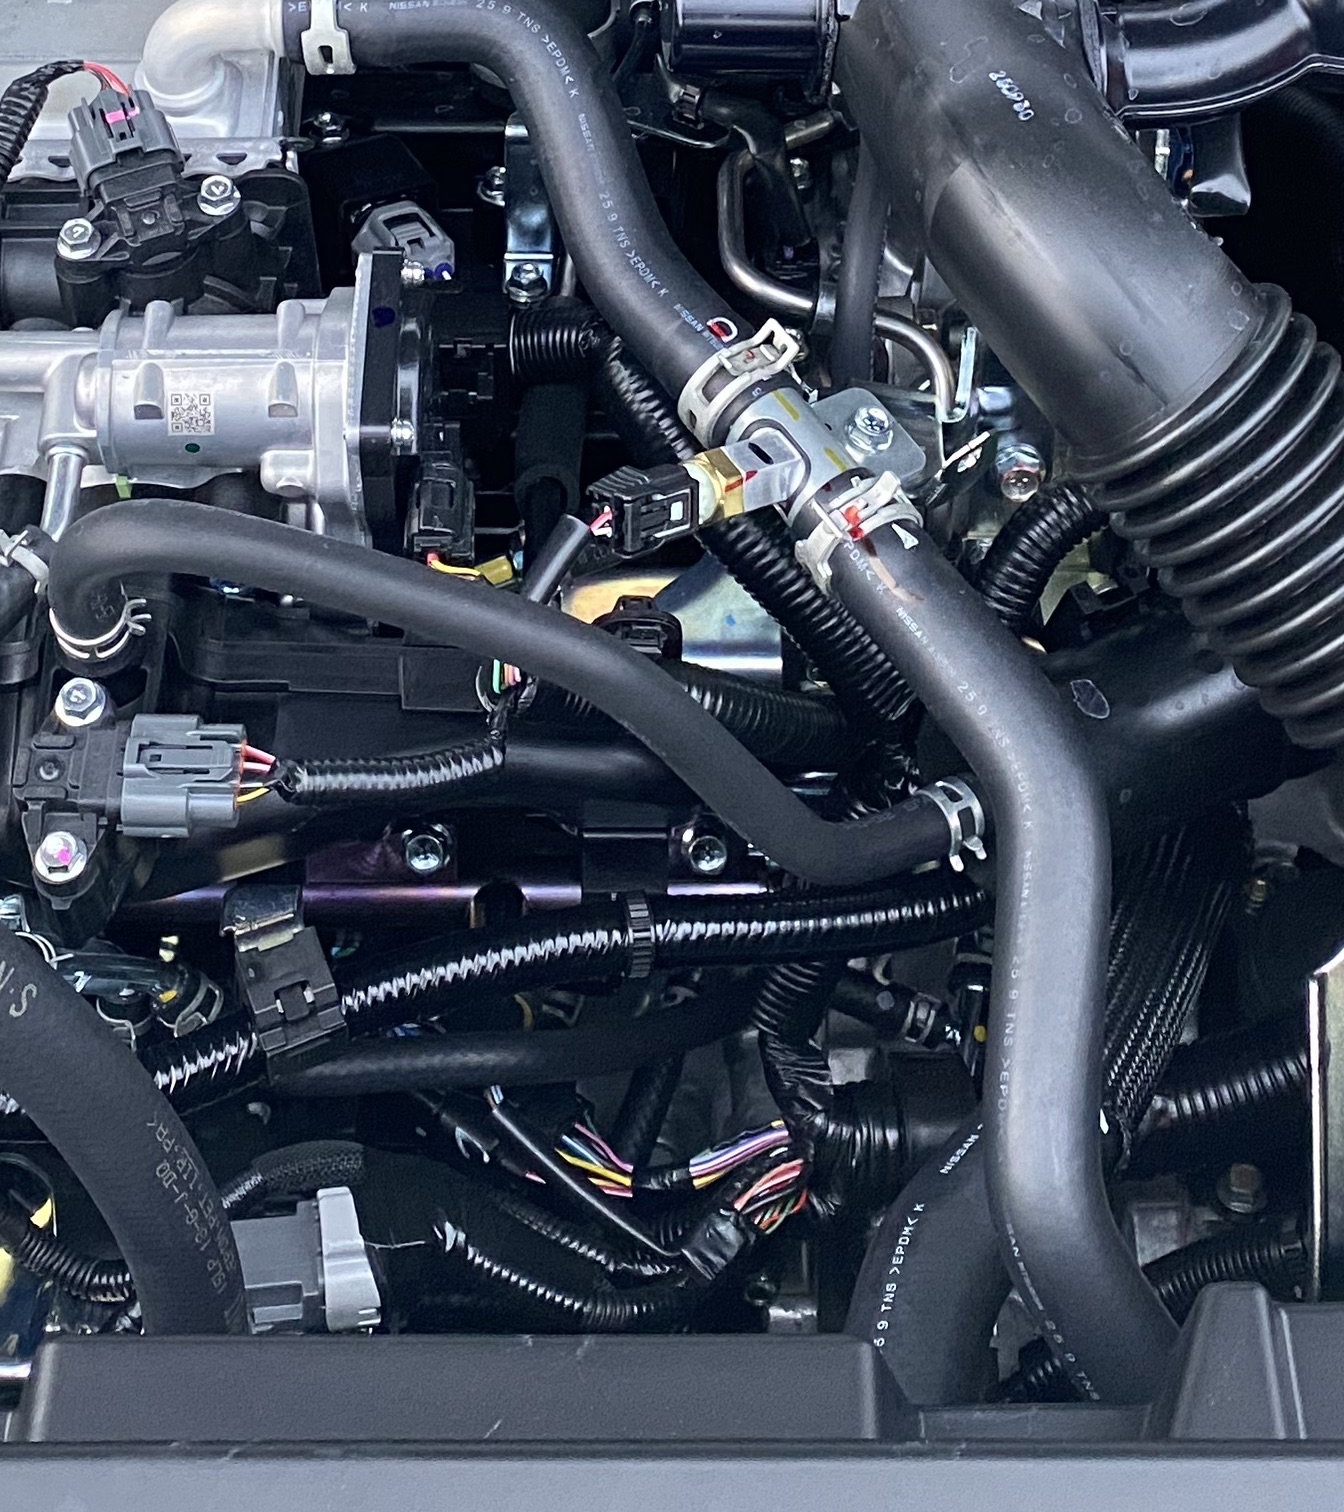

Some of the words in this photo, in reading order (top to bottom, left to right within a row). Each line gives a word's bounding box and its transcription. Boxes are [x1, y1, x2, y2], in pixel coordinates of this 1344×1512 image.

[389, 0, 430, 11] NISSAN
[517, 11, 542, 34] TNS
[541, 34, 575, 85] >EPDM<
[625, 249, 660, 289] >EPDM<
[939, 1134, 980, 1175] NISSAN
[913, 1202, 926, 1213] K
[888, 1217, 919, 1276] >EPDM<
[880, 1282, 896, 1313] TNS
[877, 1320, 888, 1331] 9
